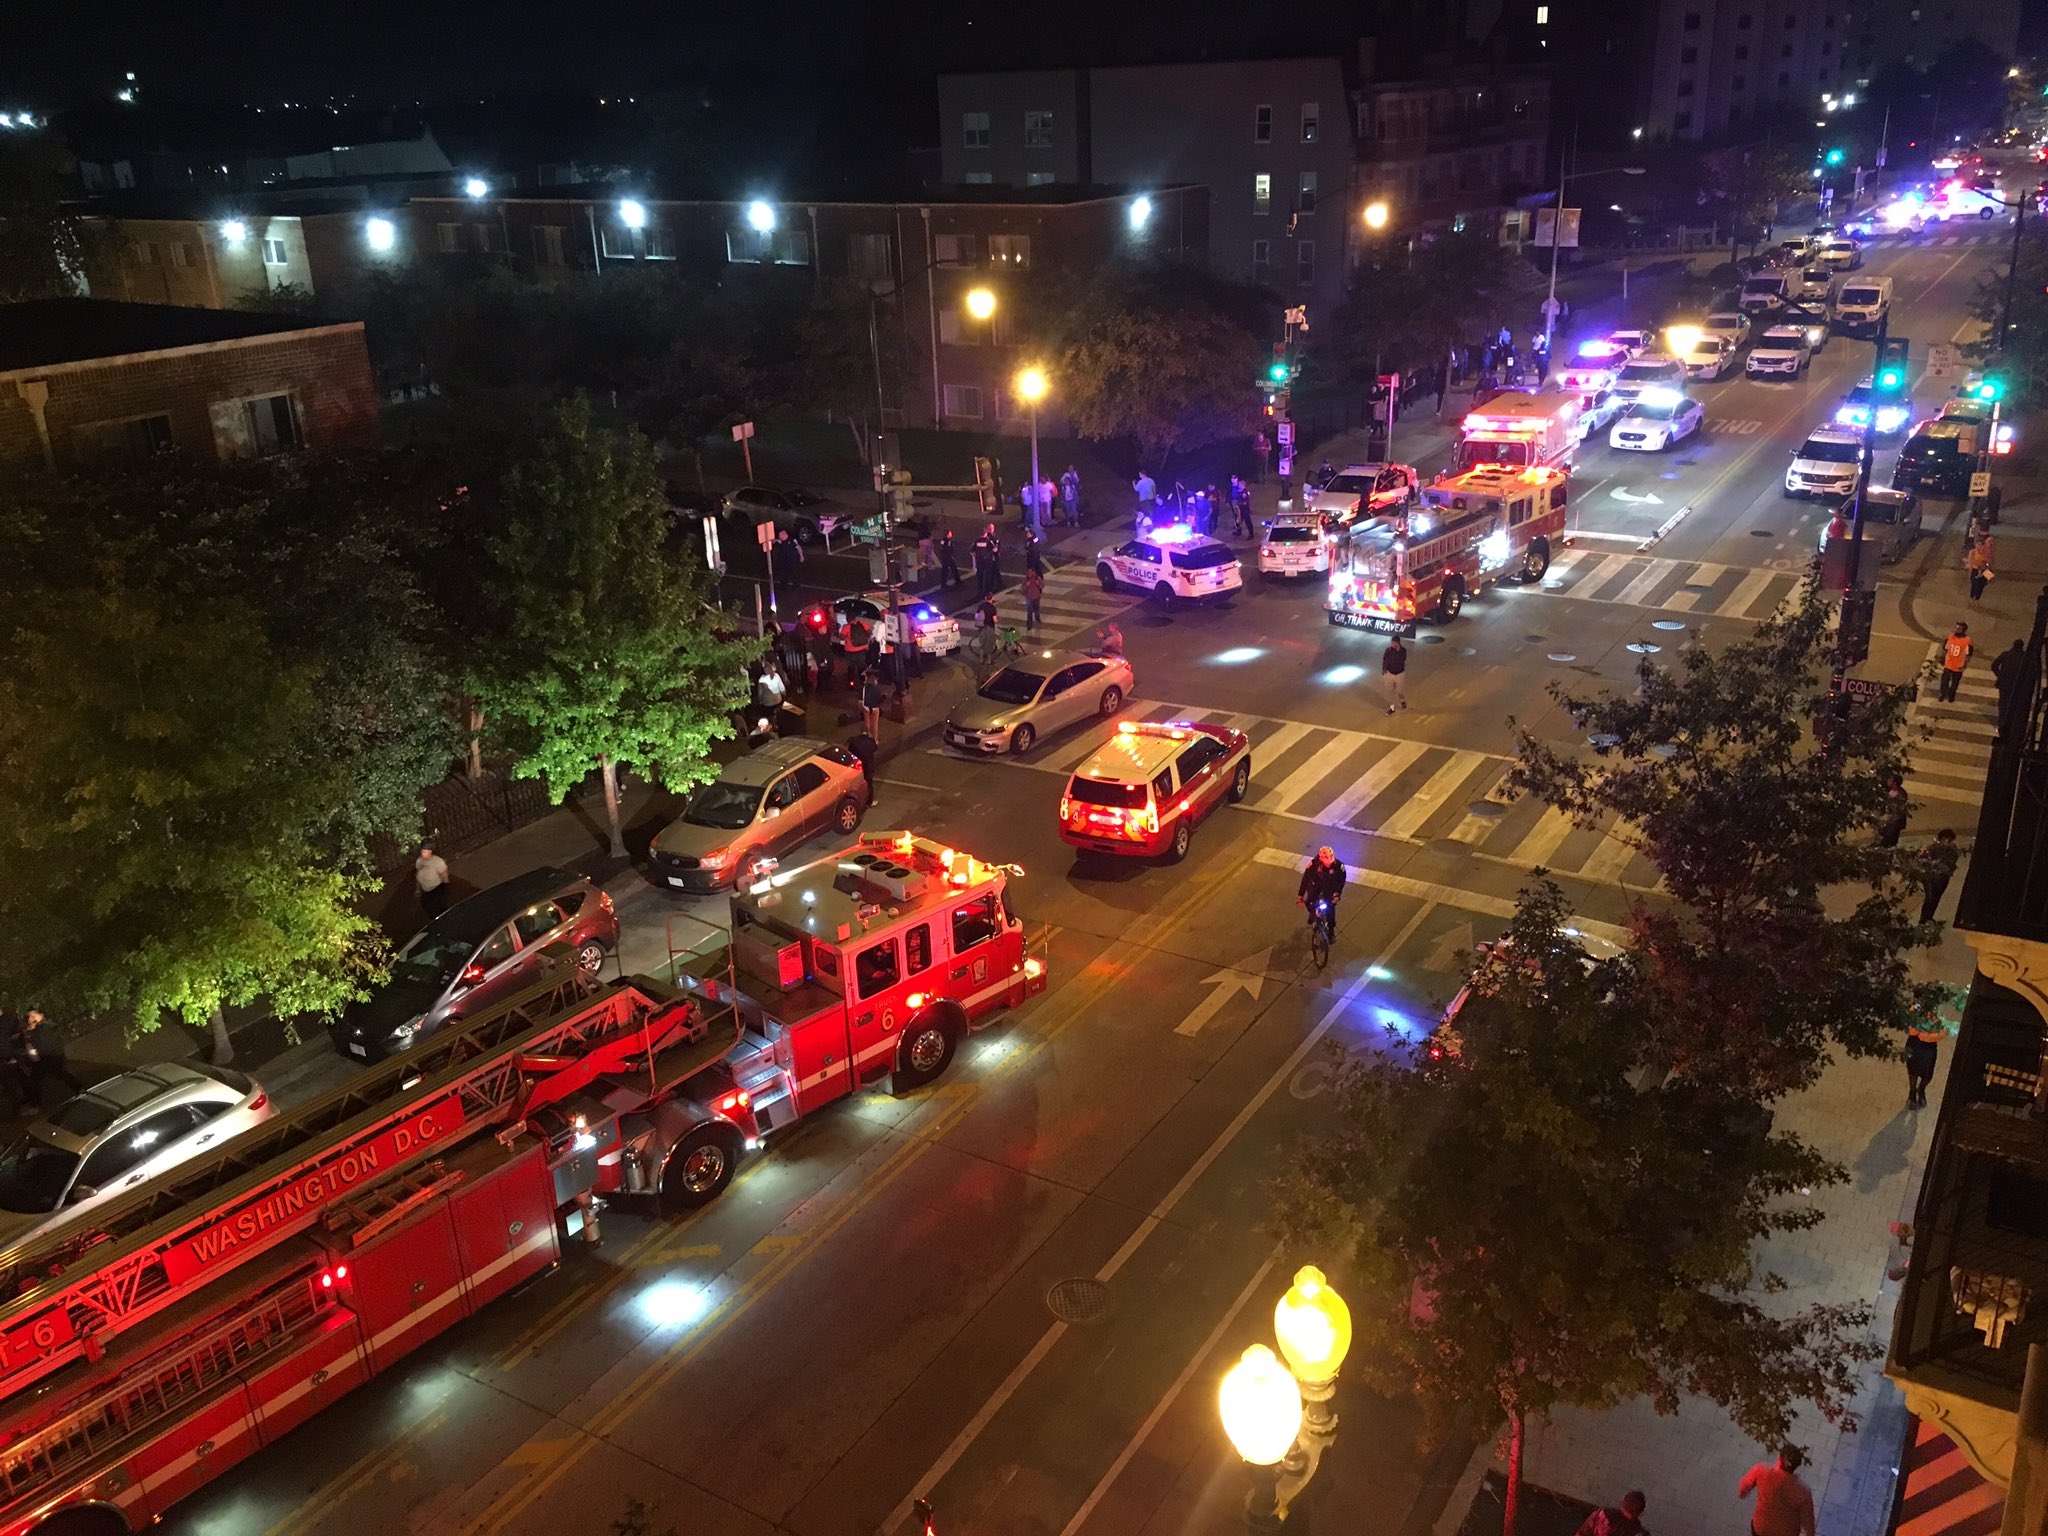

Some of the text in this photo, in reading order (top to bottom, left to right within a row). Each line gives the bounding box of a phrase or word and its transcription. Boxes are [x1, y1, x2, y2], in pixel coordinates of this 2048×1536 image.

[1127, 566, 1158, 581] POLICE
[1363, 581, 1379, 602] 11
[1949, 644, 1961, 657] 18
[874, 994, 899, 1011] TRUCK
[881, 1007, 895, 1031] 6
[191, 1115, 444, 1264] WASHINGTON D.C.
